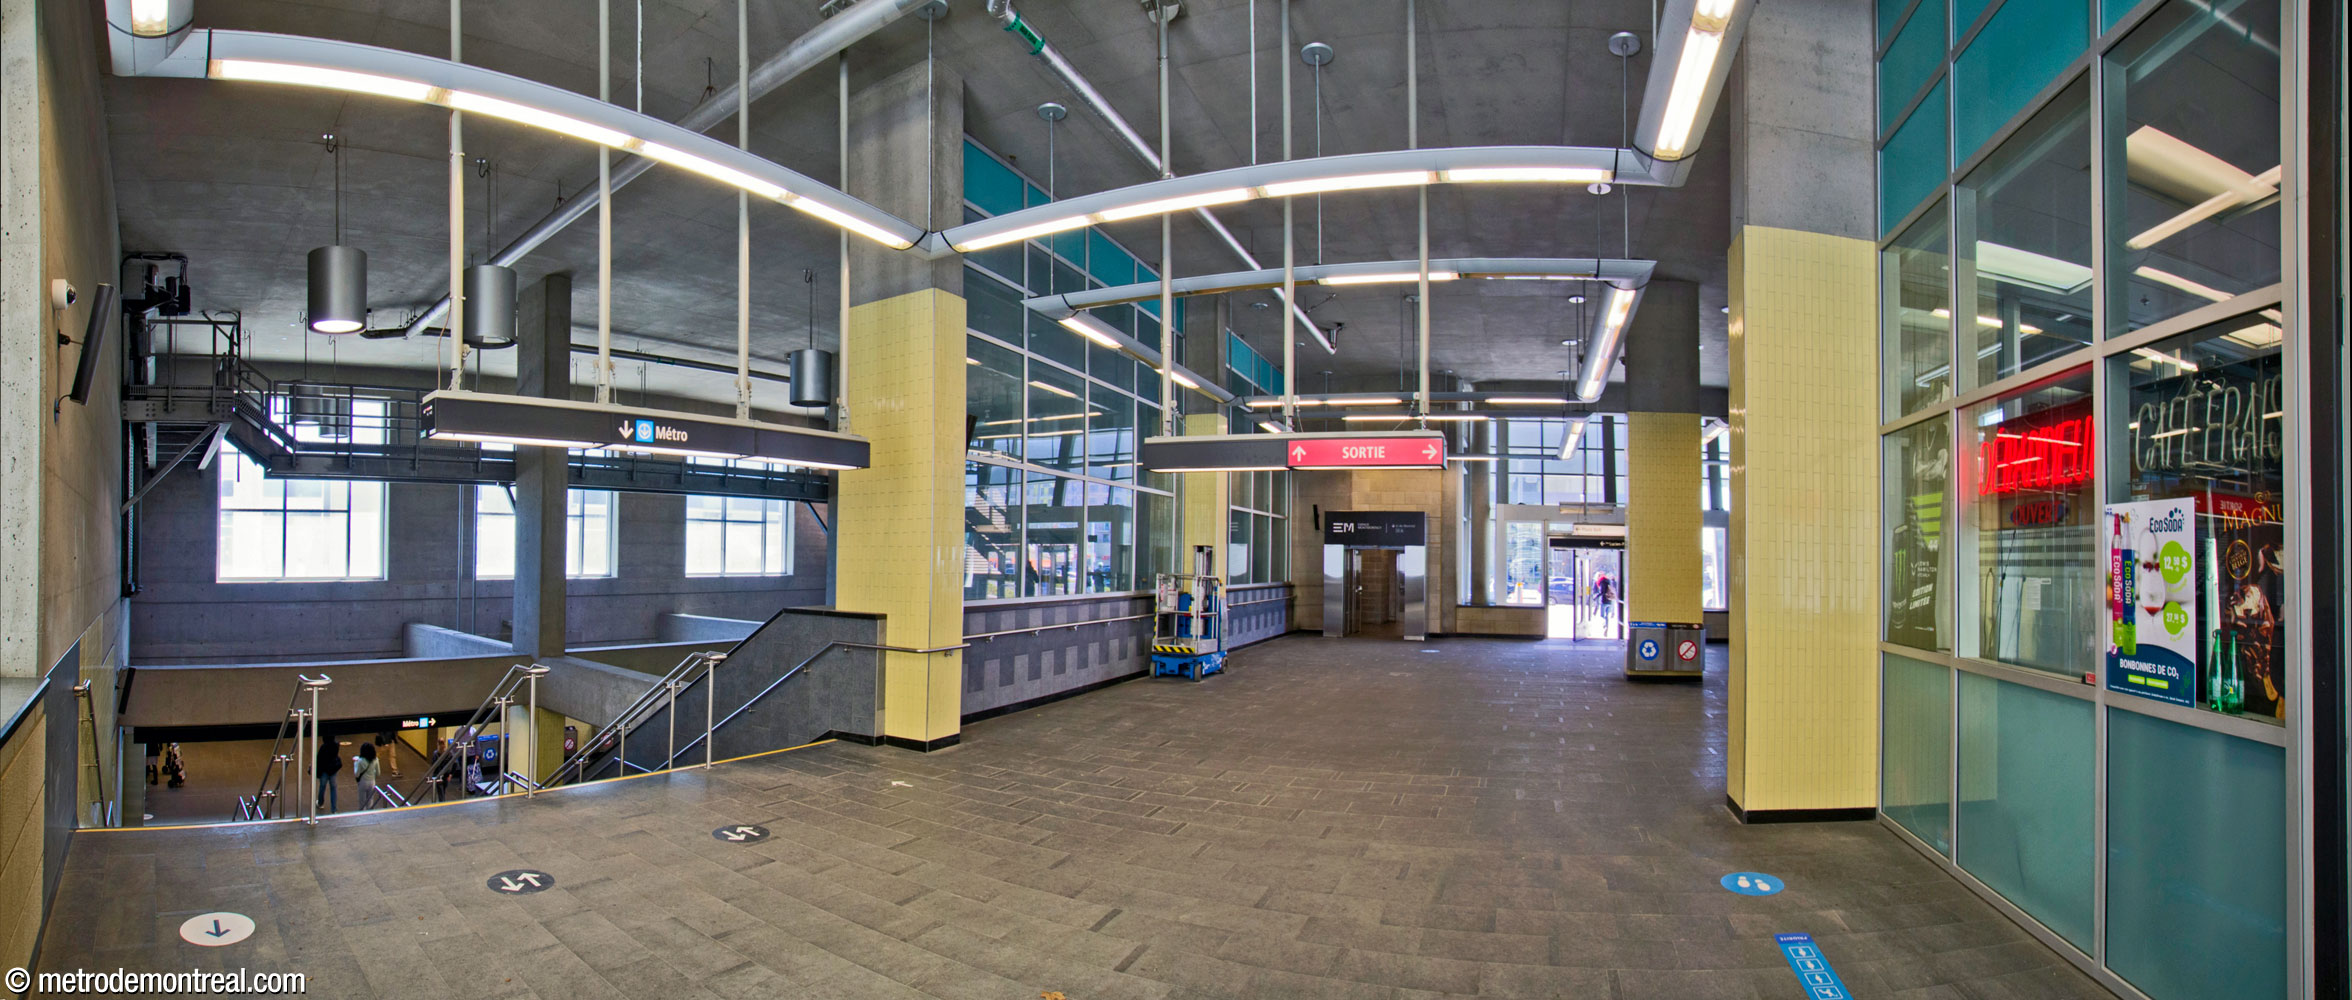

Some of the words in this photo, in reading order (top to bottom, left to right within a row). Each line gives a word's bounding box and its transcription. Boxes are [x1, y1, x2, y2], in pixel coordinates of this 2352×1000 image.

[655, 426, 688, 442] Métro
[1342, 446, 1386, 459] SORTIE
[2012, 500, 2061, 526] OUVERT
[1333, 522, 1355, 533] EM
[2119, 658, 2156, 674] BONBONNES
[2157, 664, 2166, 676] DE
[402, 720, 419, 728] Métro
